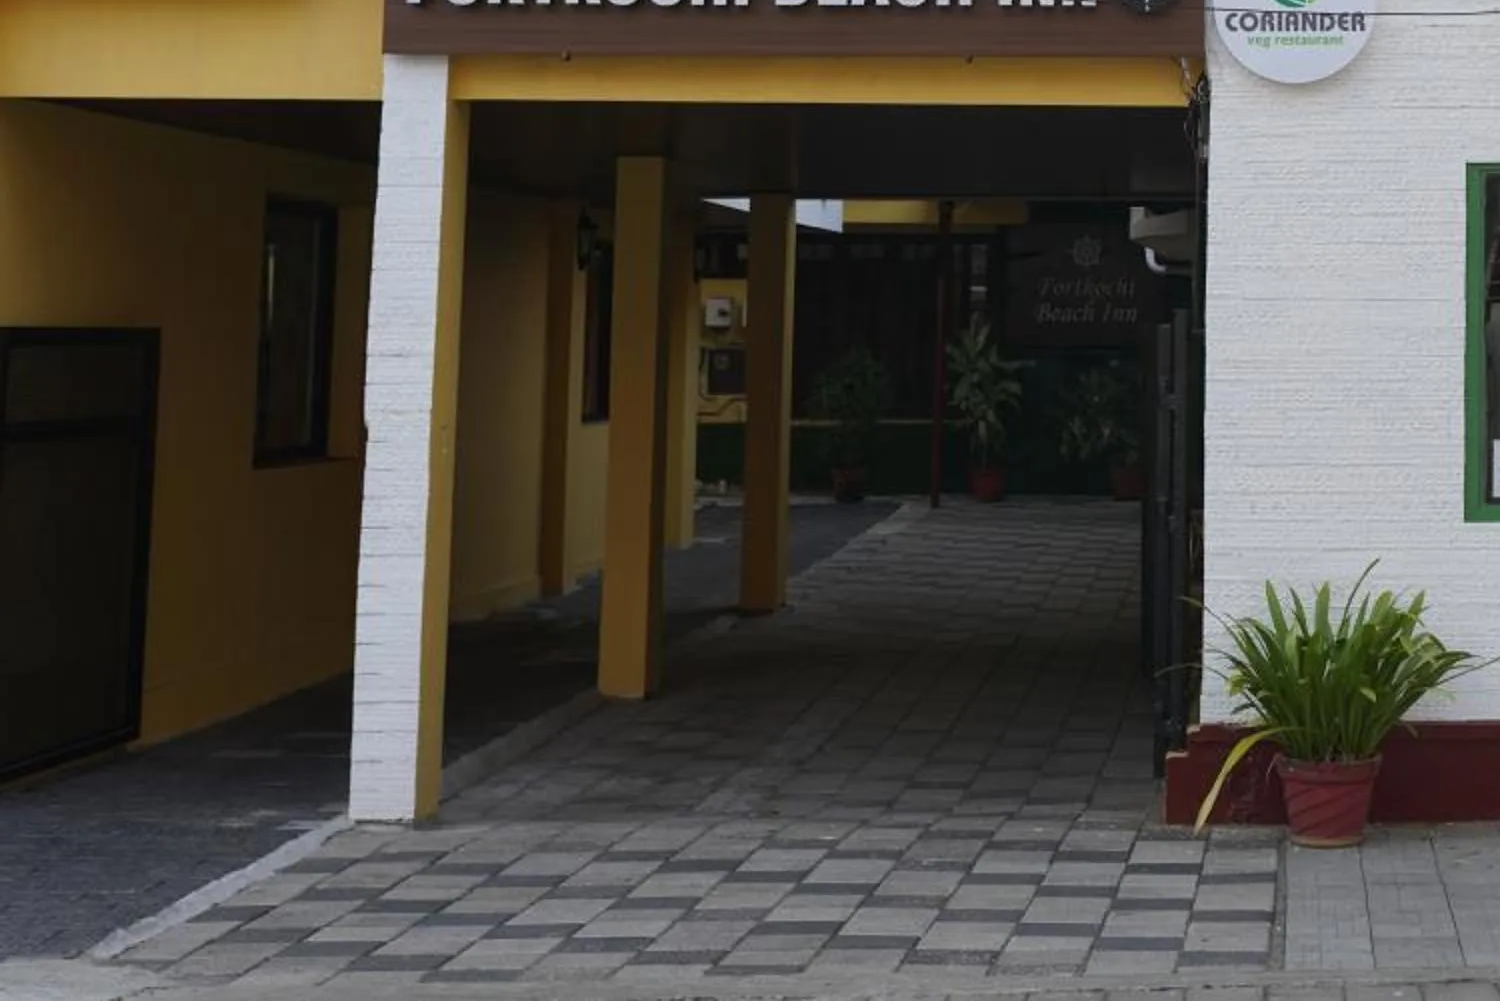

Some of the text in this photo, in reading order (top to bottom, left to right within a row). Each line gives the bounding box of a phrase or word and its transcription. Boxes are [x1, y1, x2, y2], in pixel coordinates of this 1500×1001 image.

[1225, 11, 1366, 32] CORIANDER
[1248, 34, 1344, 48] veg restaurant
[1035, 302, 1096, 324] Beach
